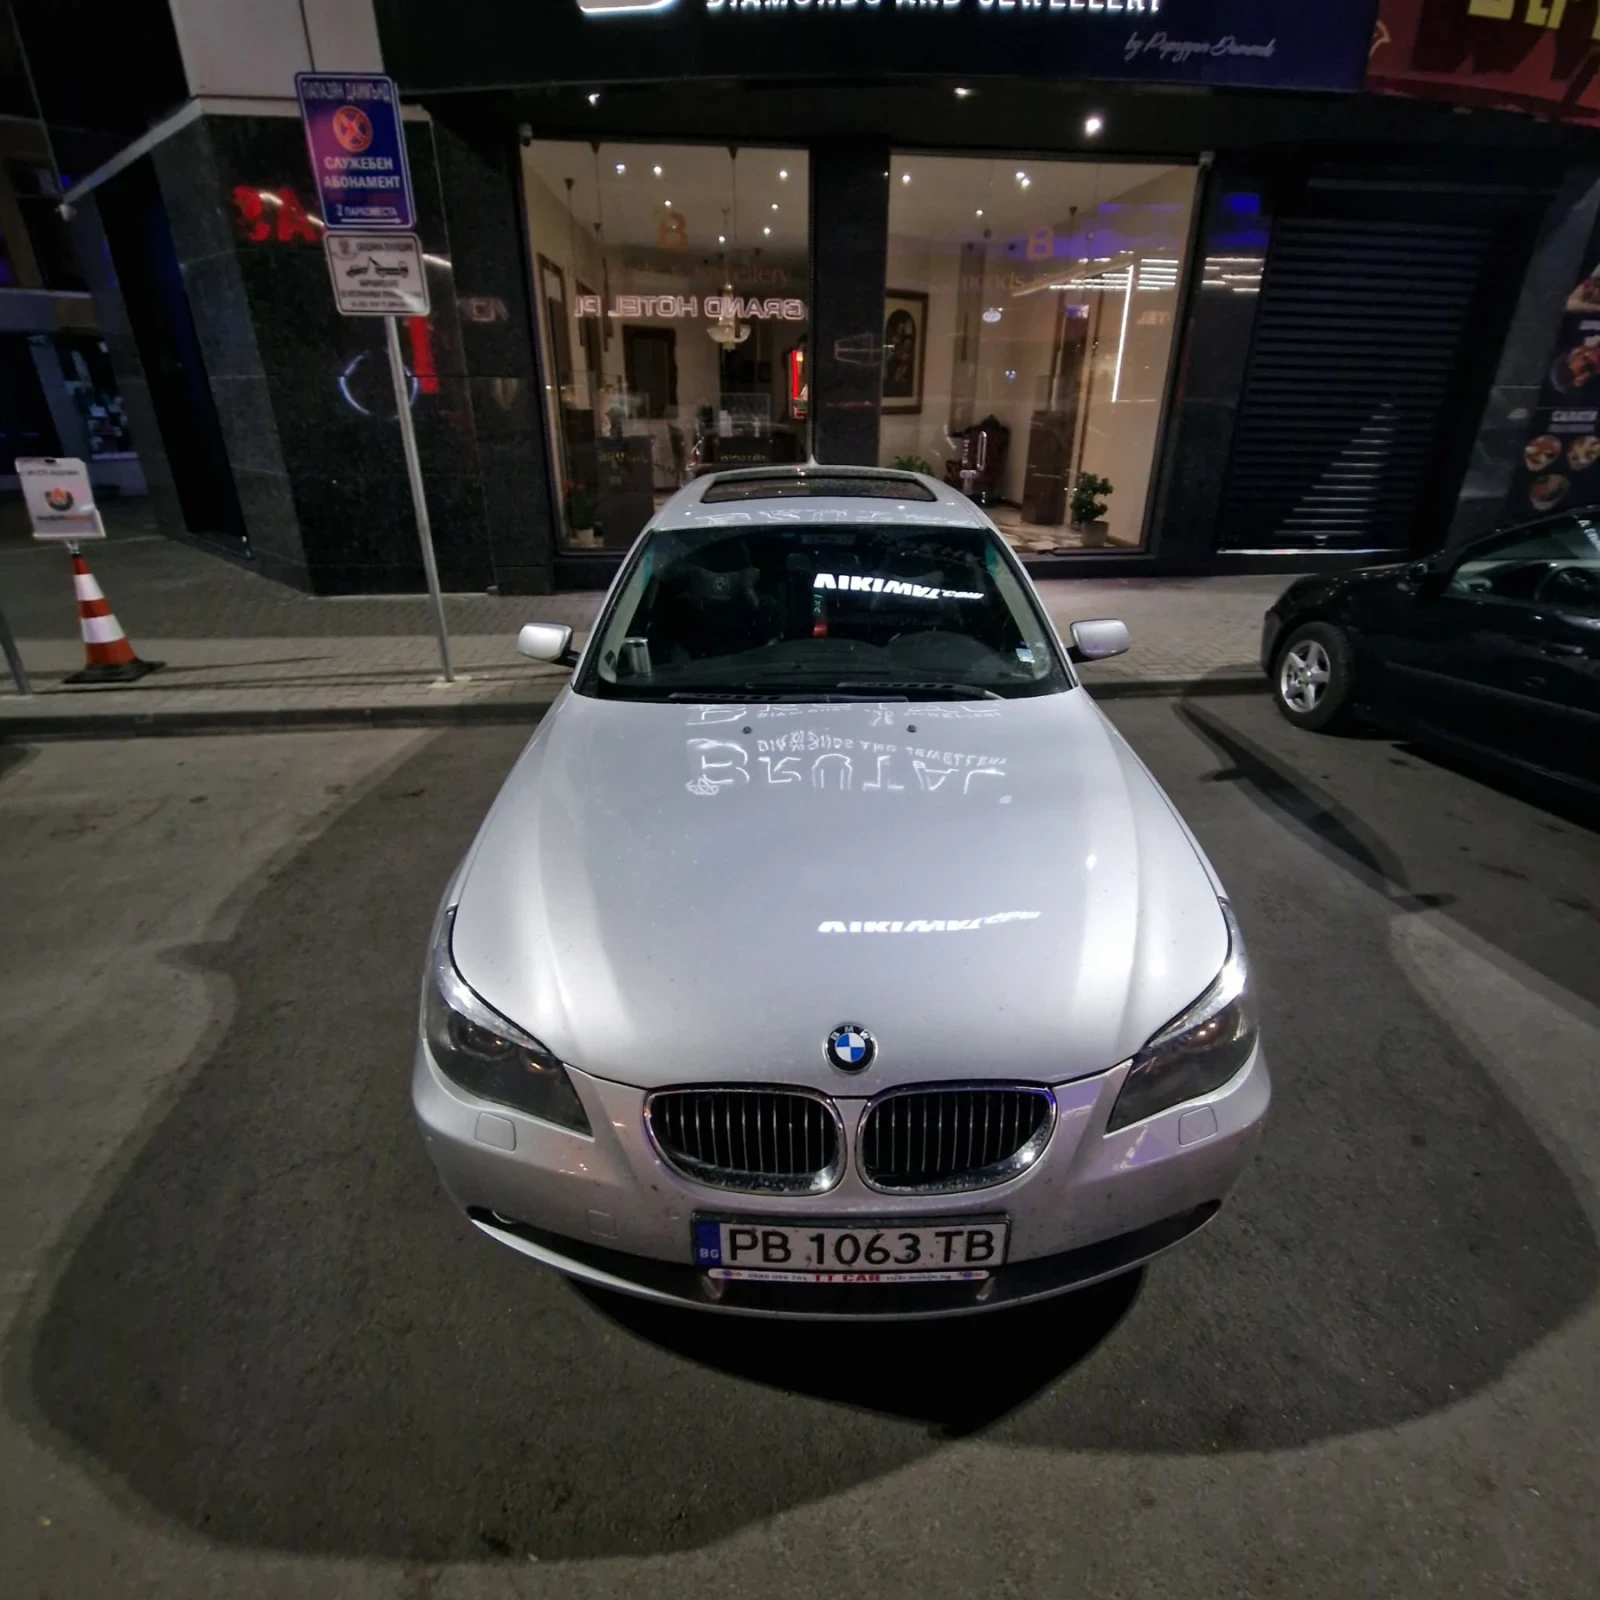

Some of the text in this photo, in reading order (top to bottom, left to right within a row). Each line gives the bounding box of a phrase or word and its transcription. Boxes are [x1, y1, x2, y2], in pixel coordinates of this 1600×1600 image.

[1124, 31, 1143, 63] by
[323, 155, 394, 170] СЛУЖЕБЕН
[323, 175, 401, 189] АБОНАМЕНТ
[336, 204, 343, 217] 2
[700, 1228, 995, 1266] BG PB 1063 TB
[842, 1273, 881, 1282] CAR
